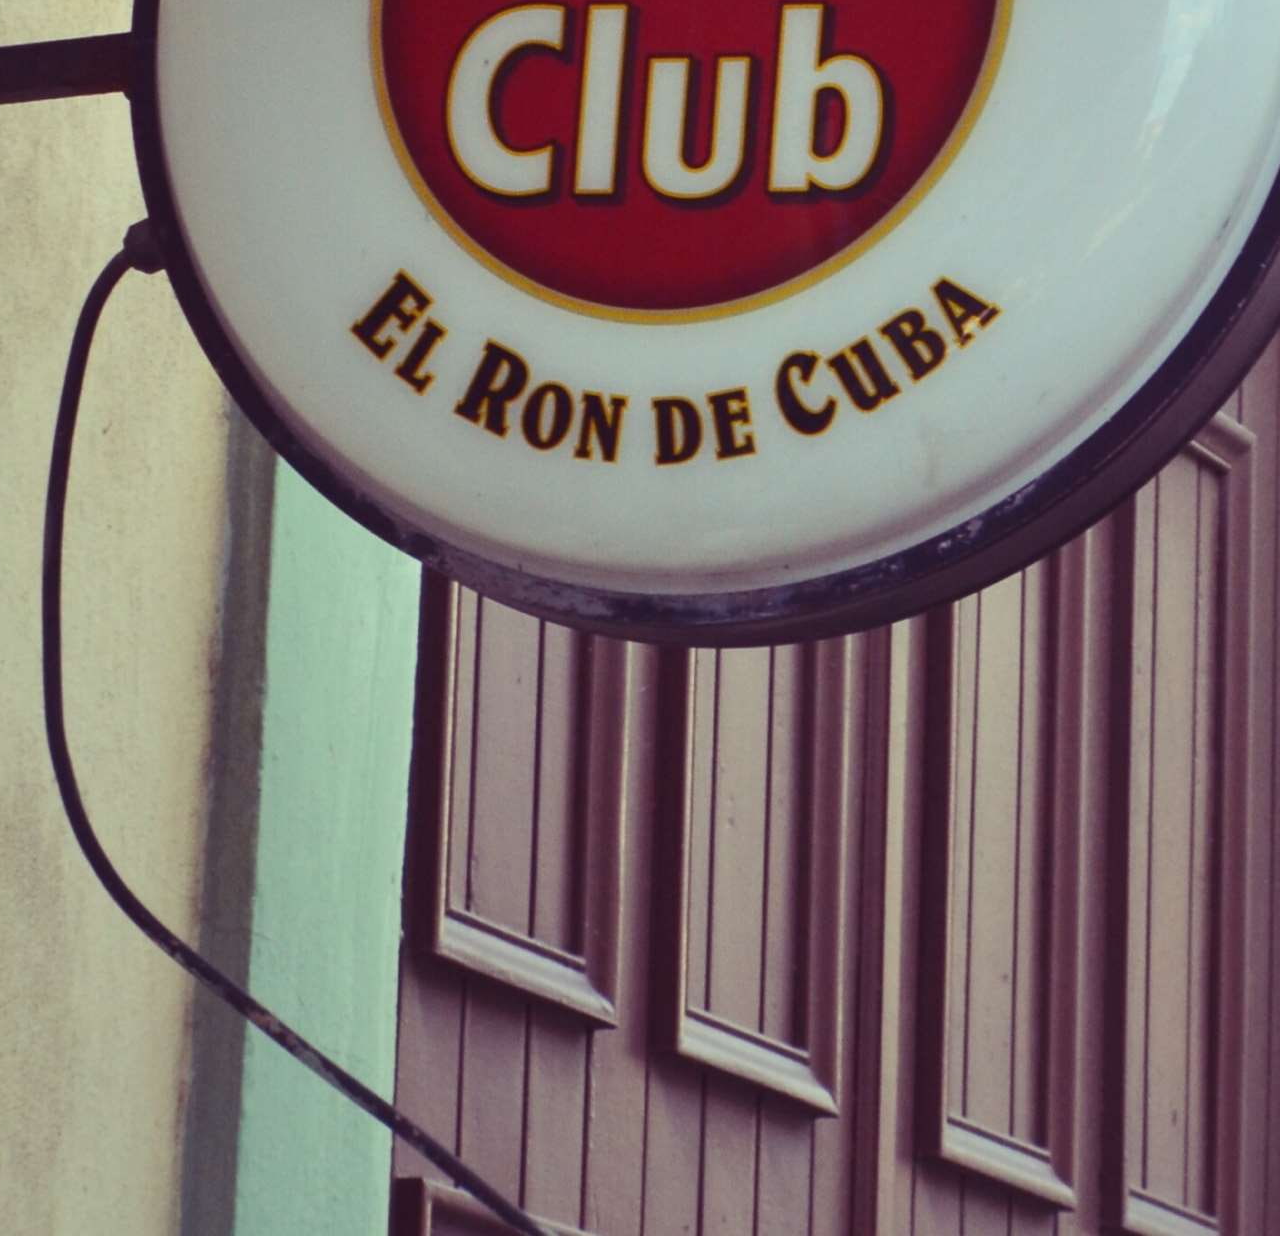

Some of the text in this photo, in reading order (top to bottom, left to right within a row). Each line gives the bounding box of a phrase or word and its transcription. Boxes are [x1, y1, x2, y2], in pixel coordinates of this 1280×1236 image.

[445, 2, 892, 206] Club
[348, 268, 1003, 466] EL RON DE CUBA
